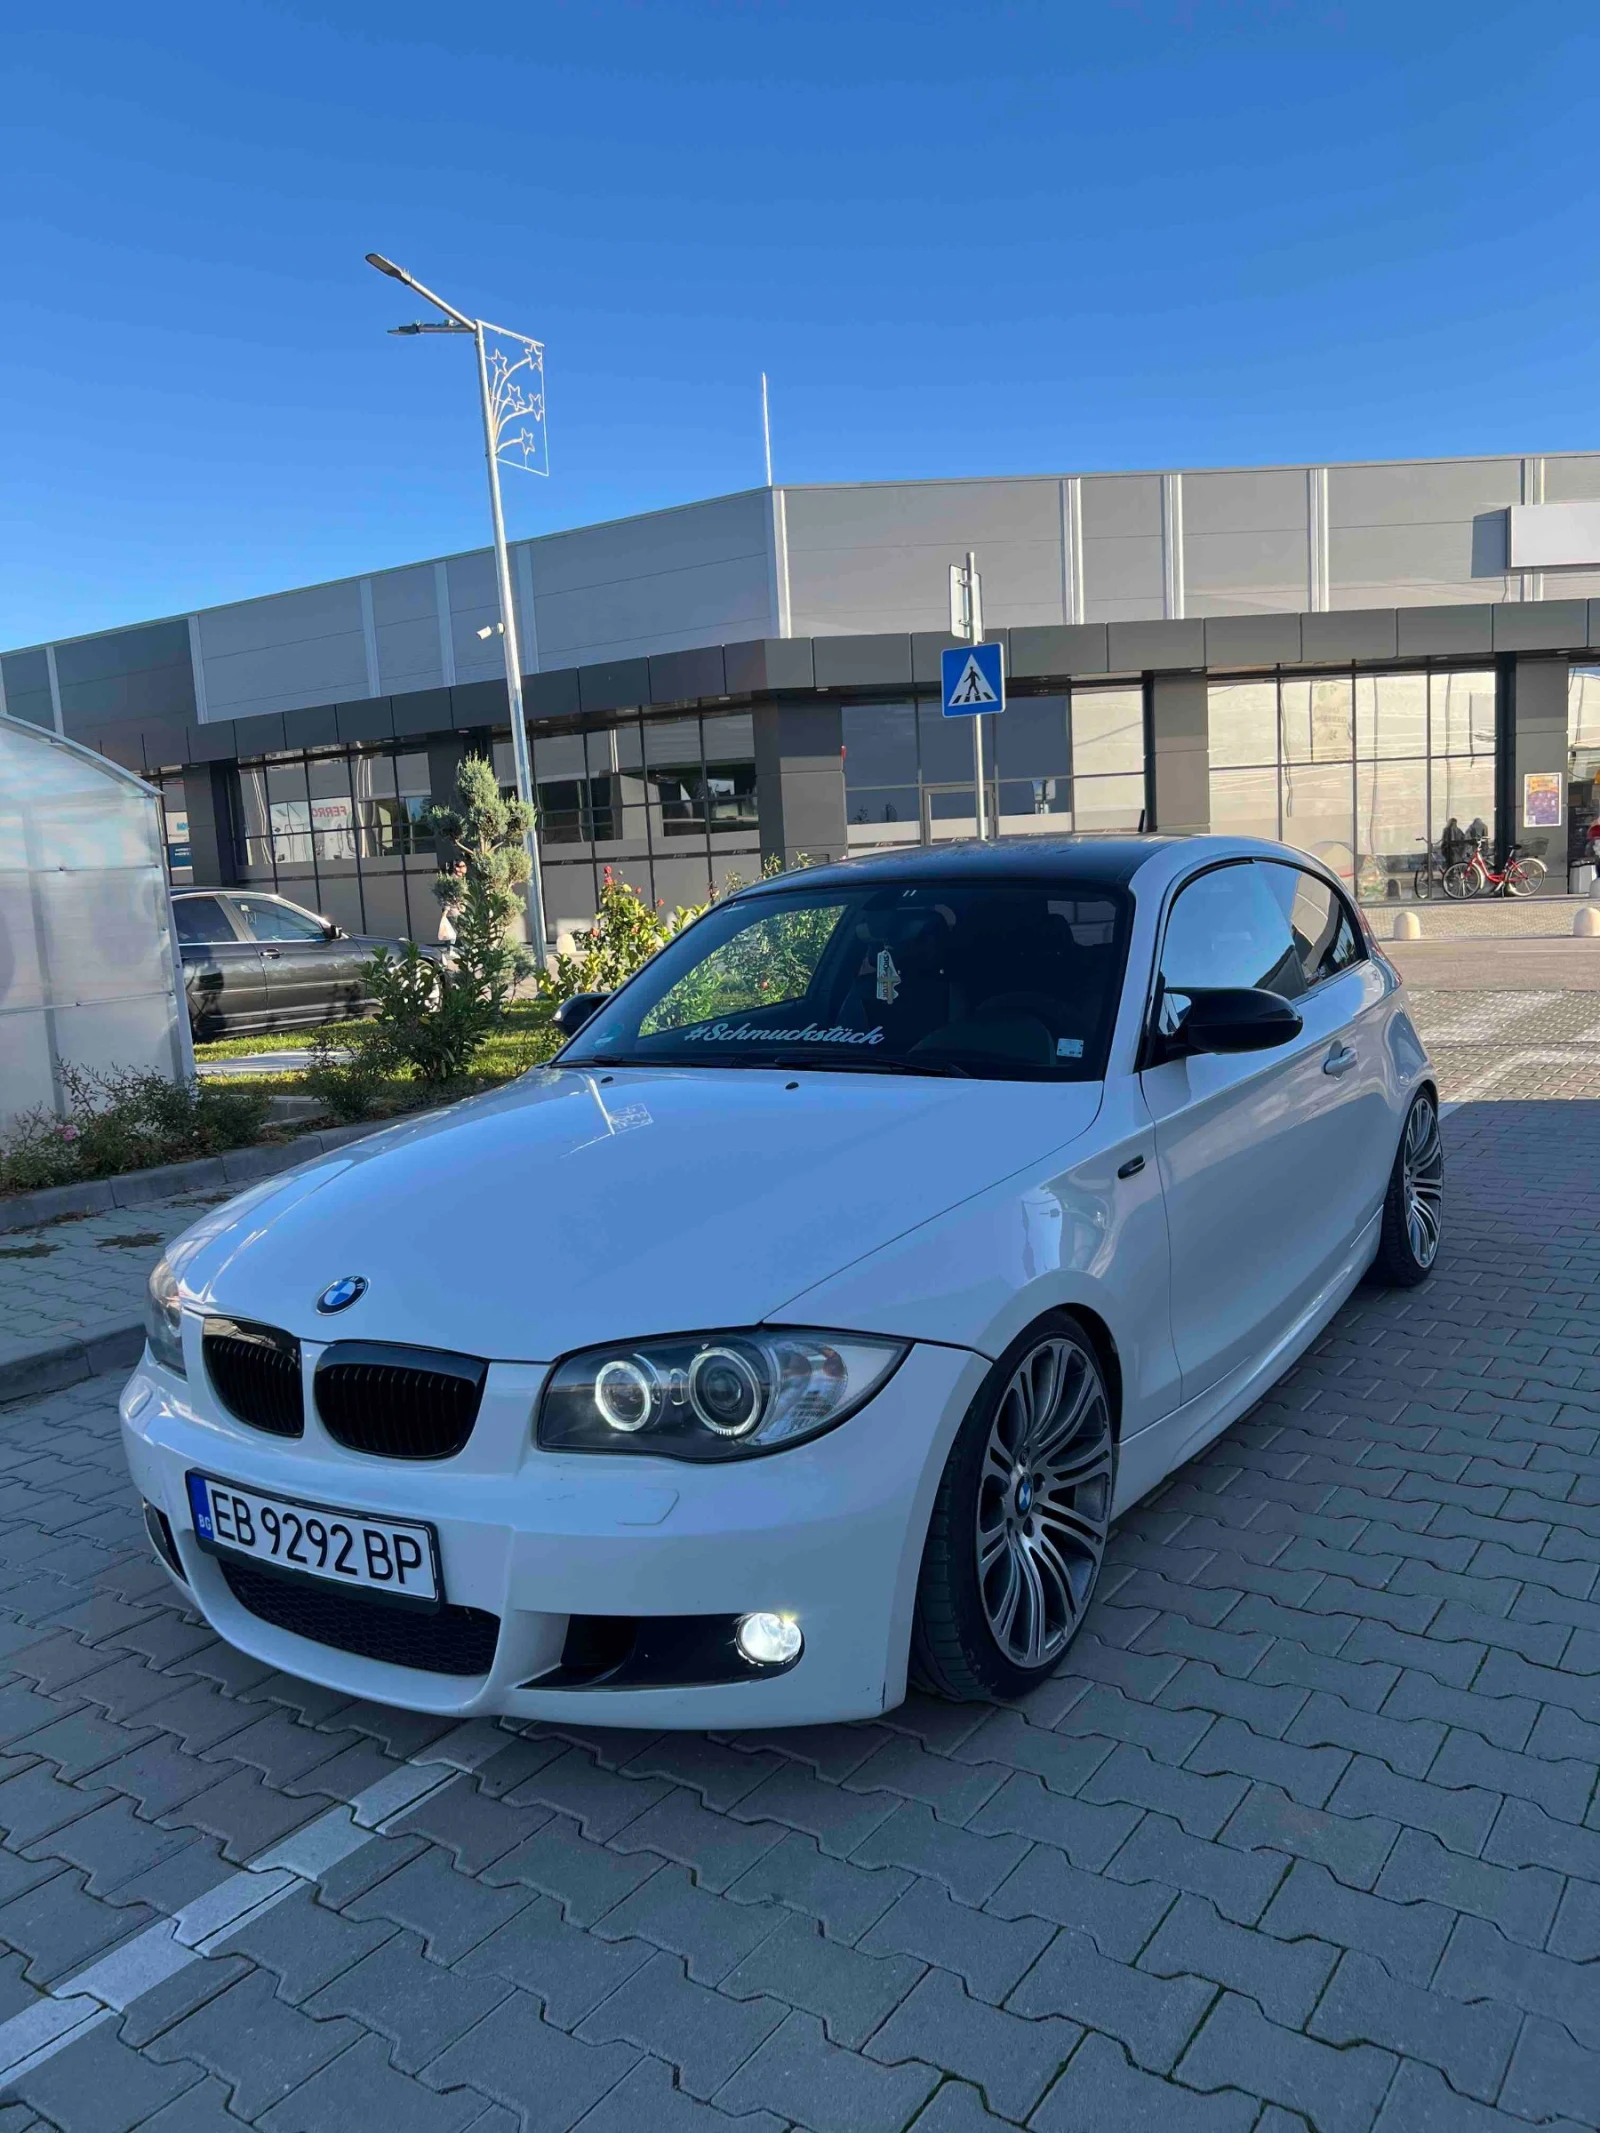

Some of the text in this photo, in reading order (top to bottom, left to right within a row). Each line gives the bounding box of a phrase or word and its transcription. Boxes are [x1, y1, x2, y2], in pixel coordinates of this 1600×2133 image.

[684, 1022, 885, 1045] #Schmuckstück
[198, 1513, 212, 1531] BG
[211, 1488, 422, 1585] EB 9292 BP
